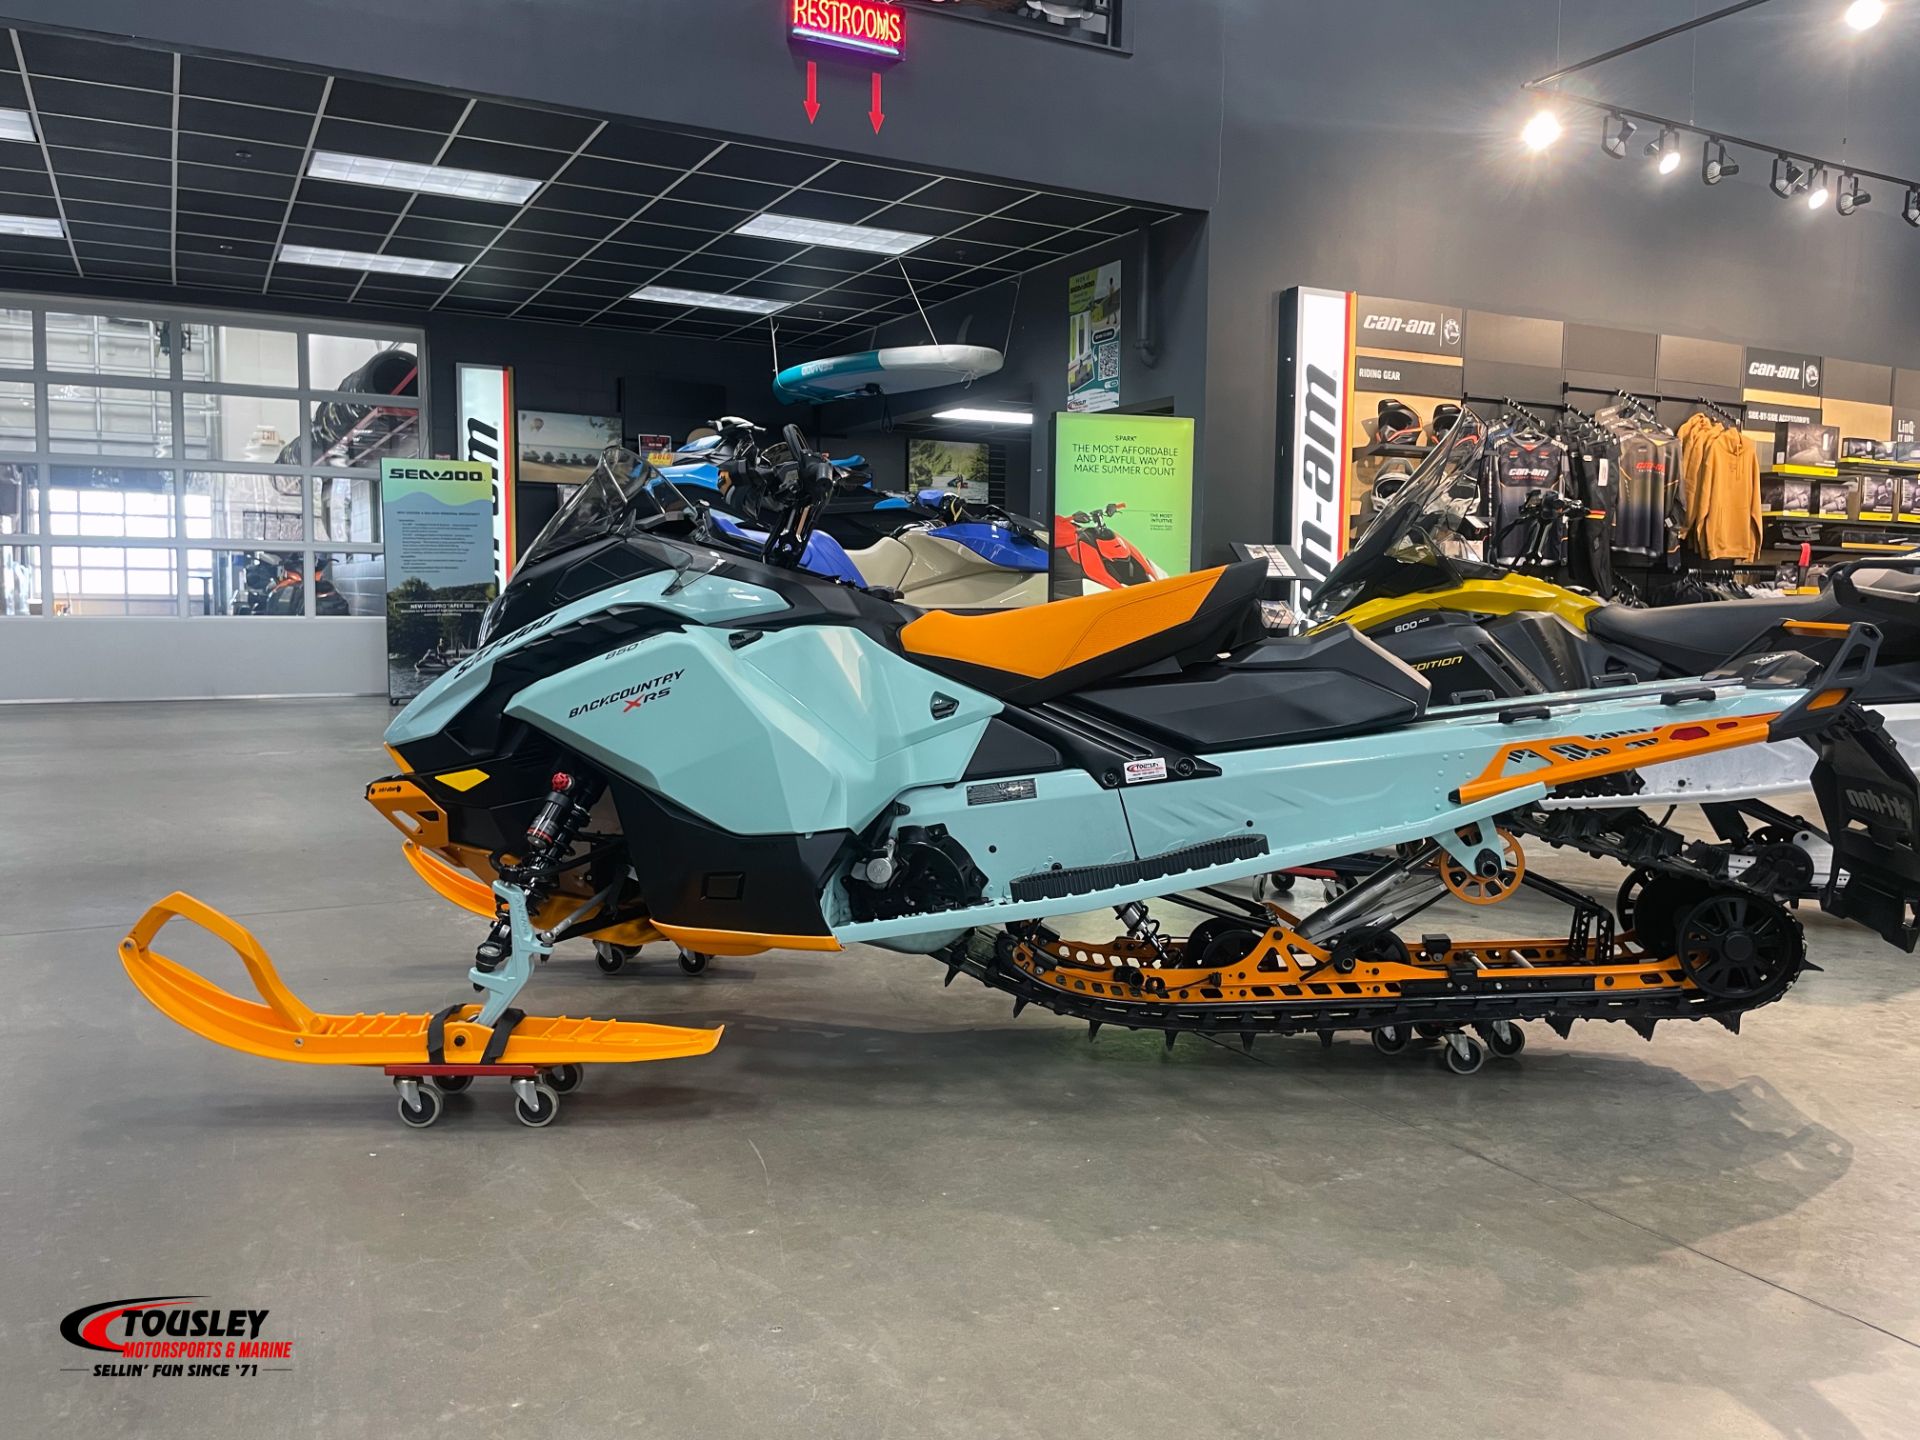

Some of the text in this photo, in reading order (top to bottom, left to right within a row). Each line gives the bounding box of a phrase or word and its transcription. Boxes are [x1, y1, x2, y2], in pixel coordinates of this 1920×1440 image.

[793, 0, 901, 42] RESTROOMS
[1363, 314, 1436, 336] can-am
[1359, 367, 1401, 381] RIDING GEAR
[1749, 361, 1800, 380] can-am
[1072, 443, 1179, 456] THE MOST AFFORDABLE
[1076, 454, 1174, 466] AND PLAYFUL WAY TO
[1073, 464, 1176, 476] MAKE SUMMER COUNT
[1394, 620, 1418, 633] 600
[568, 668, 685, 719] BACKCOUNTRY
